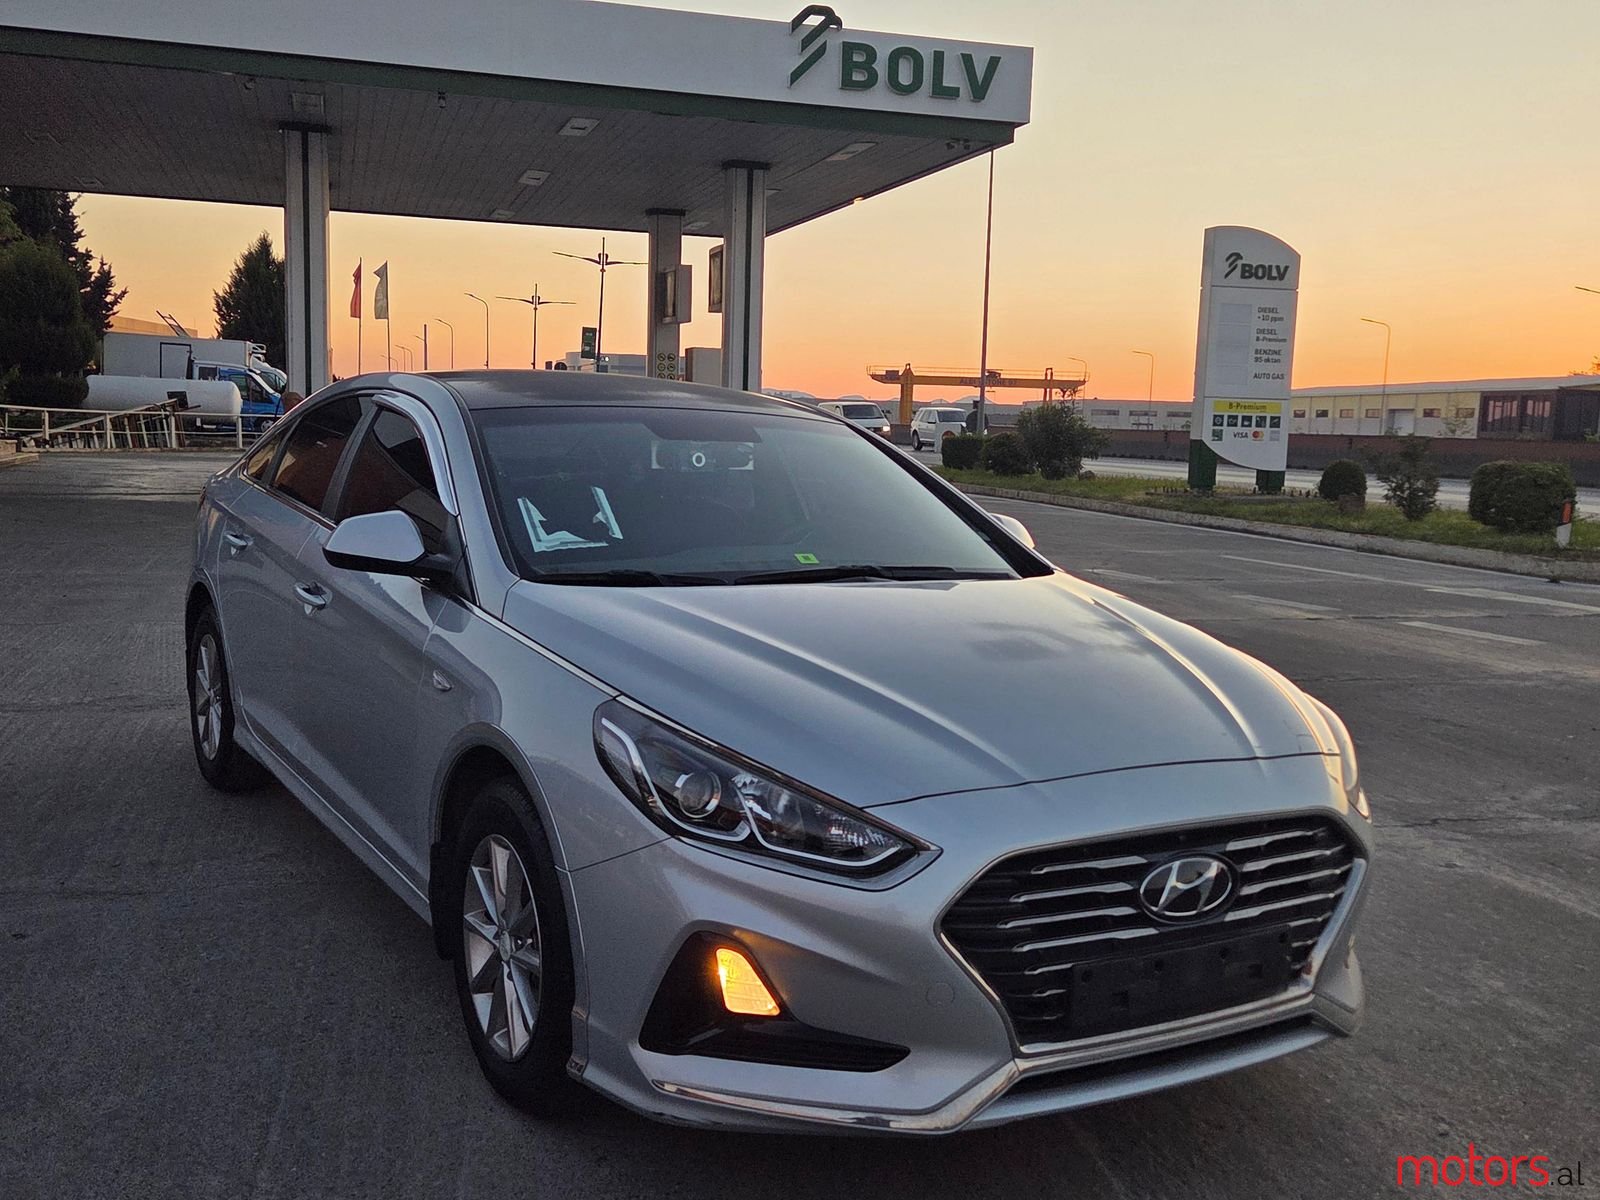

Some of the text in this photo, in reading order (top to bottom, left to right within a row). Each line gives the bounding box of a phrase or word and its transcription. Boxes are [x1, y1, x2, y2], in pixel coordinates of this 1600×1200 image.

[839, 41, 1002, 102] BOLV
[1240, 263, 1290, 281] BOLV
[1257, 306, 1279, 314] DIESEL
[1255, 335, 1288, 343] B-Premium
[1254, 348, 1282, 356] BENZINE
[1263, 356, 1281, 364] oktan
[1253, 372, 1285, 380] AUTO GAS
[1228, 402, 1267, 410] B-Premium
[1233, 431, 1249, 439] VISA
